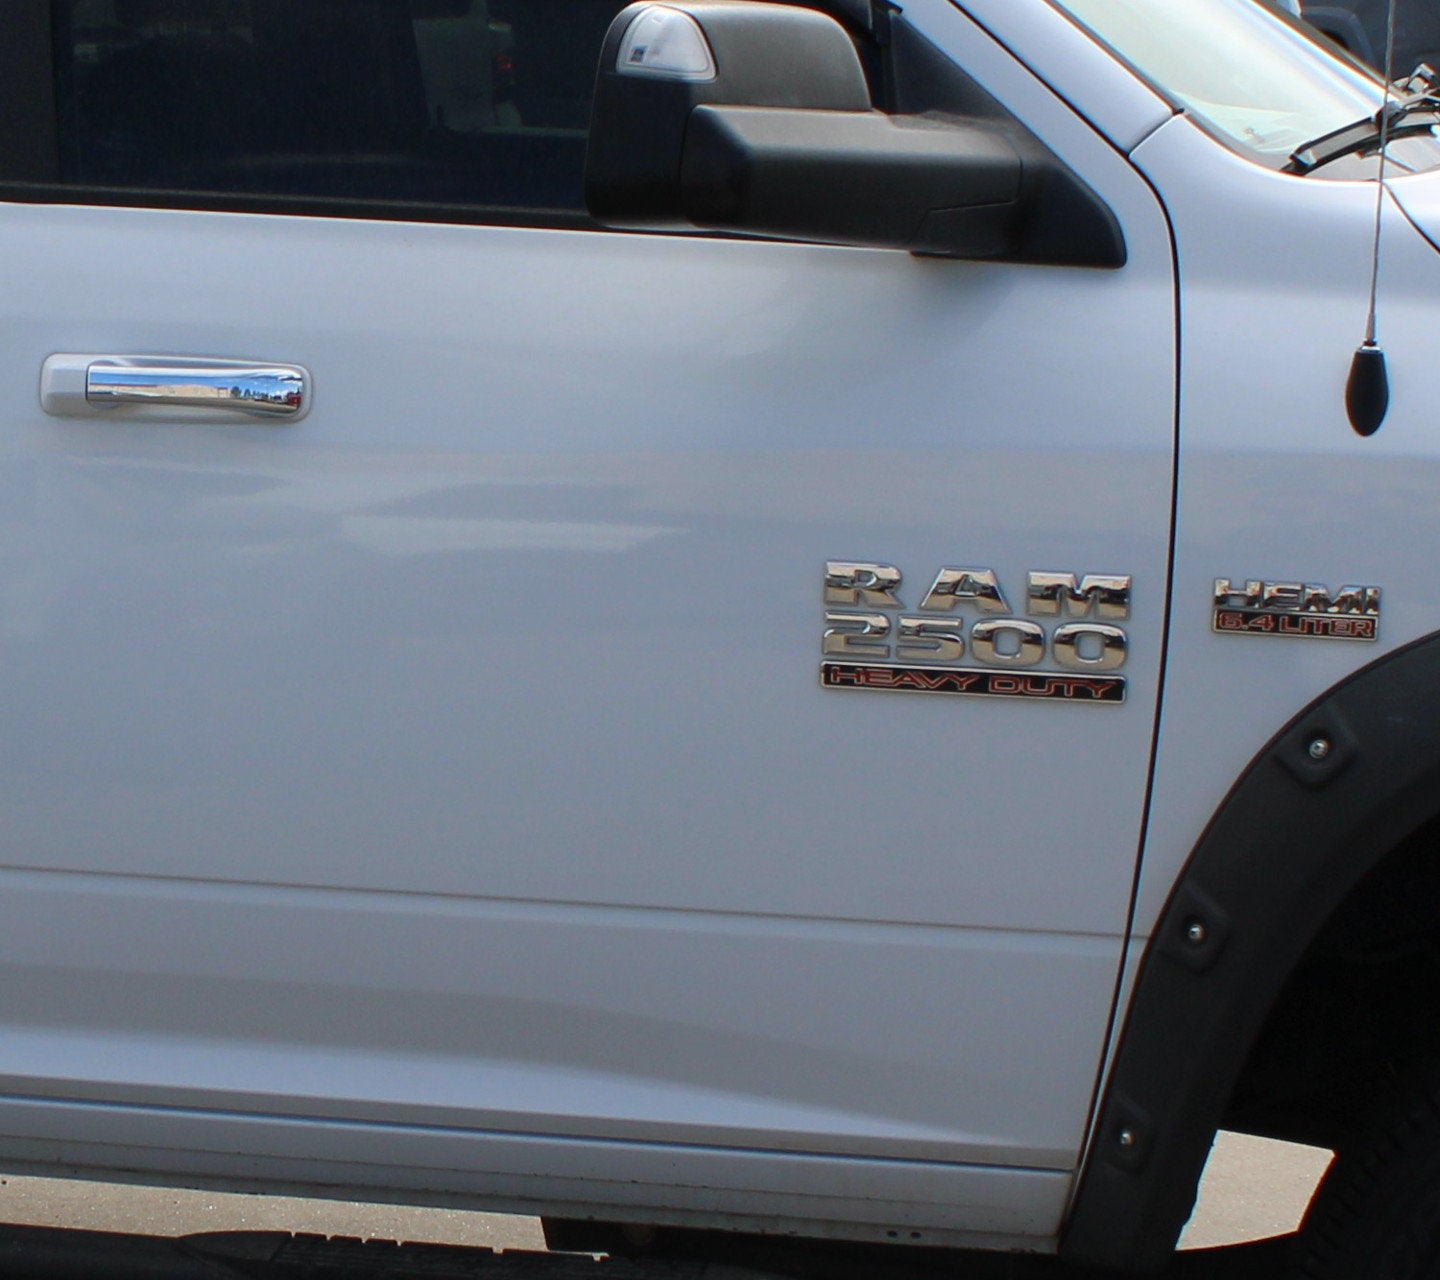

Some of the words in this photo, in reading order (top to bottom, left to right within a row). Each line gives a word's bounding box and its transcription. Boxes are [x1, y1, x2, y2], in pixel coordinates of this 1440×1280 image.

[823, 559, 1131, 619] RAM
[1214, 577, 1381, 615] HEMI
[822, 609, 1130, 671] 2500
[1219, 612, 1275, 631] 6.4
[1279, 615, 1373, 637] LITER
[830, 666, 981, 691] HEAVY
[988, 675, 1117, 699] DUTY
